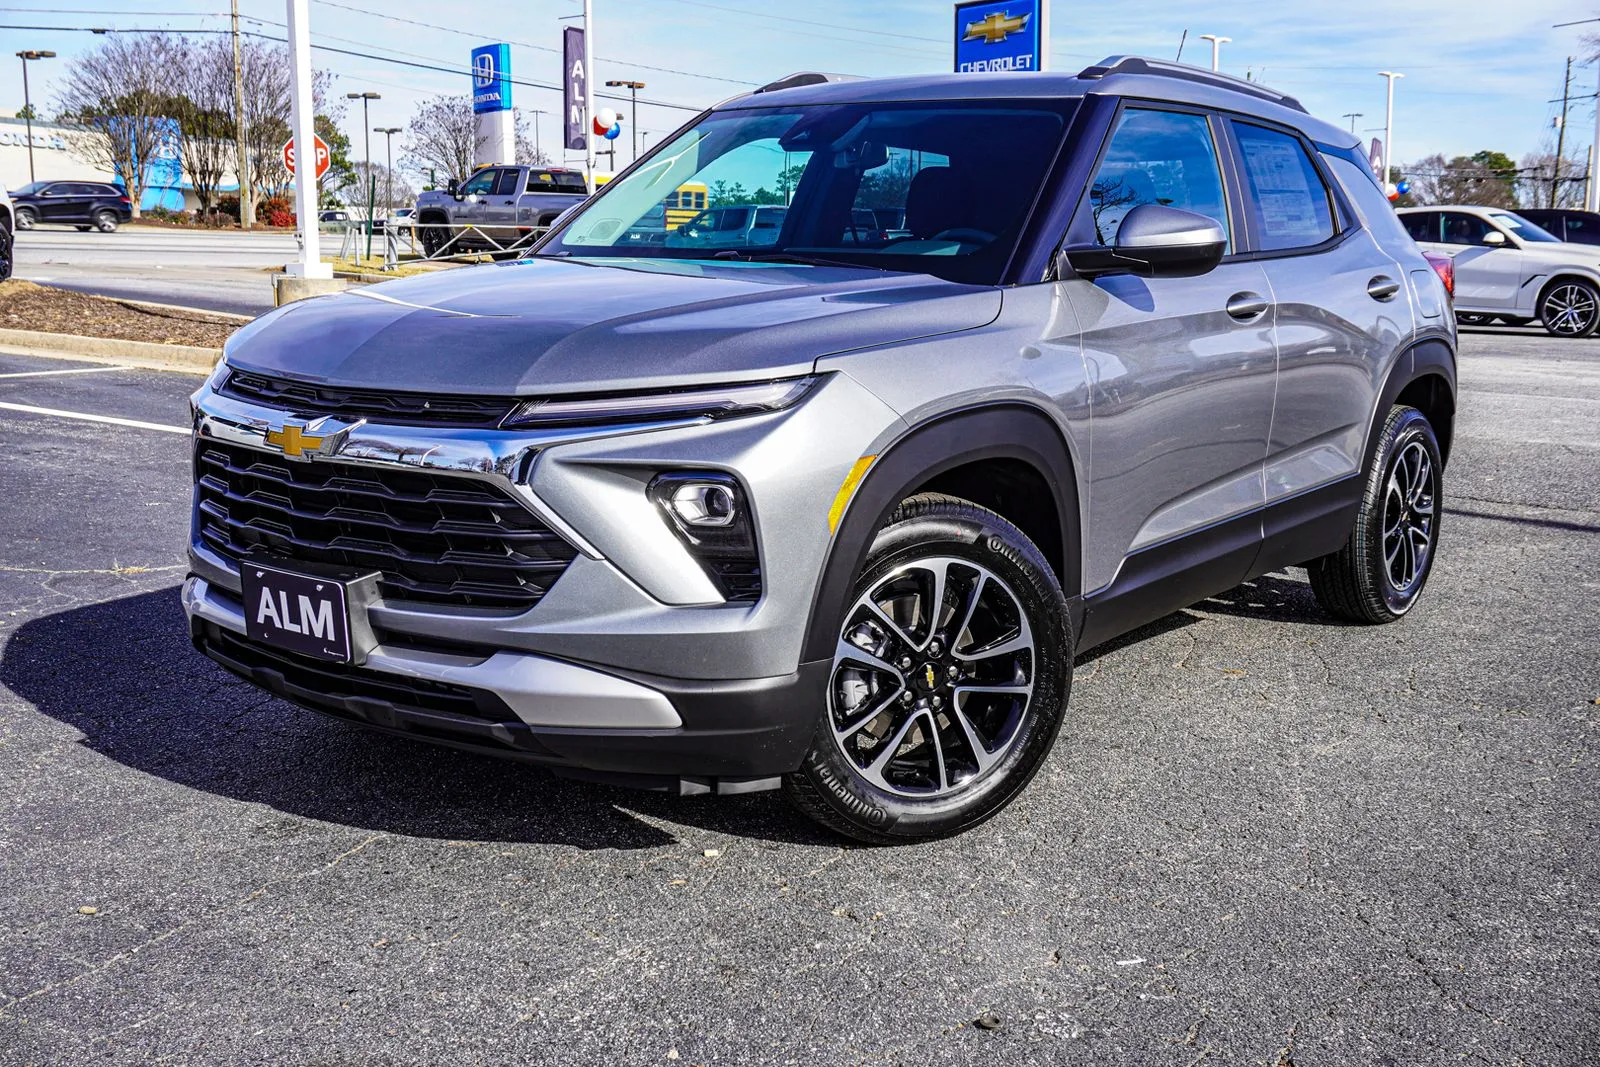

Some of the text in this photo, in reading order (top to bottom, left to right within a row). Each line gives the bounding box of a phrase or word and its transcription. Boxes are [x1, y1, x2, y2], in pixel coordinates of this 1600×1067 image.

[960, 54, 1032, 73] CHEVROLET
[287, 148, 327, 166] SP
[257, 586, 335, 641] ALM
[813, 761, 888, 826] Continental
